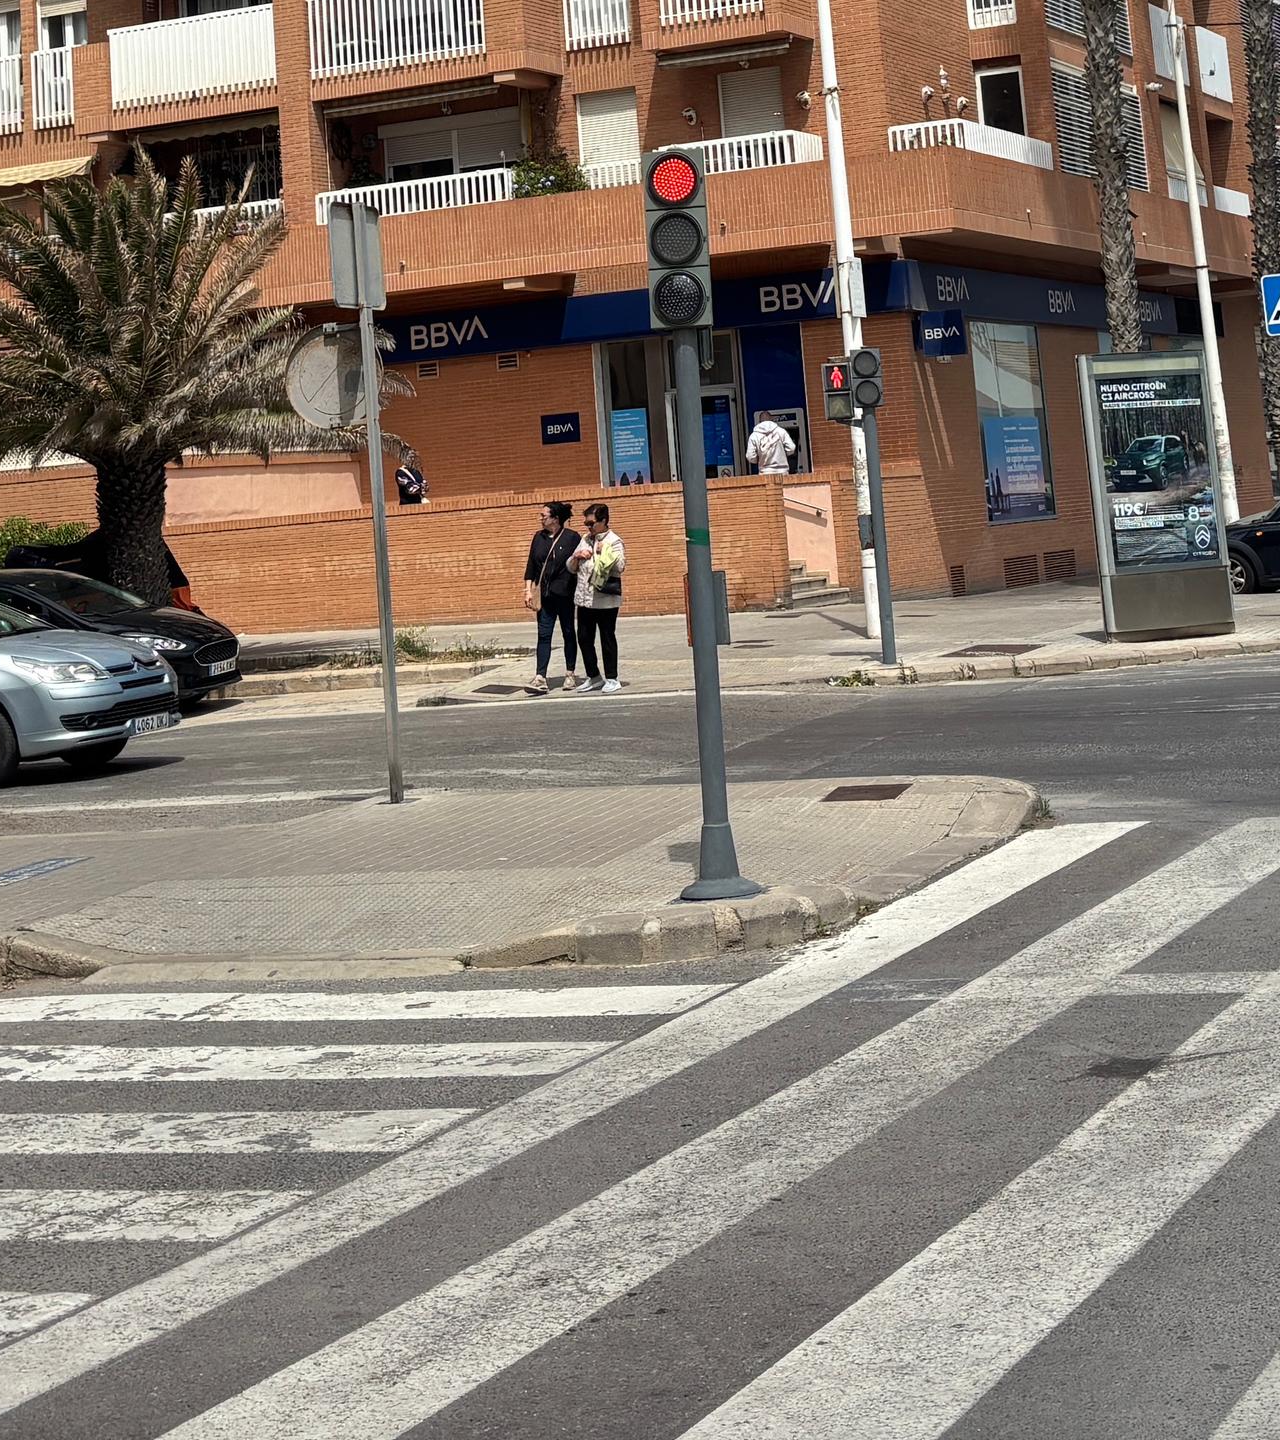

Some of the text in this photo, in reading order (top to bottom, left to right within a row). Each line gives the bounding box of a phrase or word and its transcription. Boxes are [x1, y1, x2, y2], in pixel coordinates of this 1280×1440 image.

[936, 275, 970, 302] BBVA
[1048, 290, 1076, 313] BBVA
[1139, 301, 1163, 322] BBVA
[410, 315, 489, 351] BBVA
[924, 326, 960, 339] BBVA
[1100, 384, 1130, 392] NUEVO
[1101, 391, 1155, 401] C3 AIRCROSS
[547, 423, 574, 435] BBVA
[1188, 506, 1200, 521] 8
